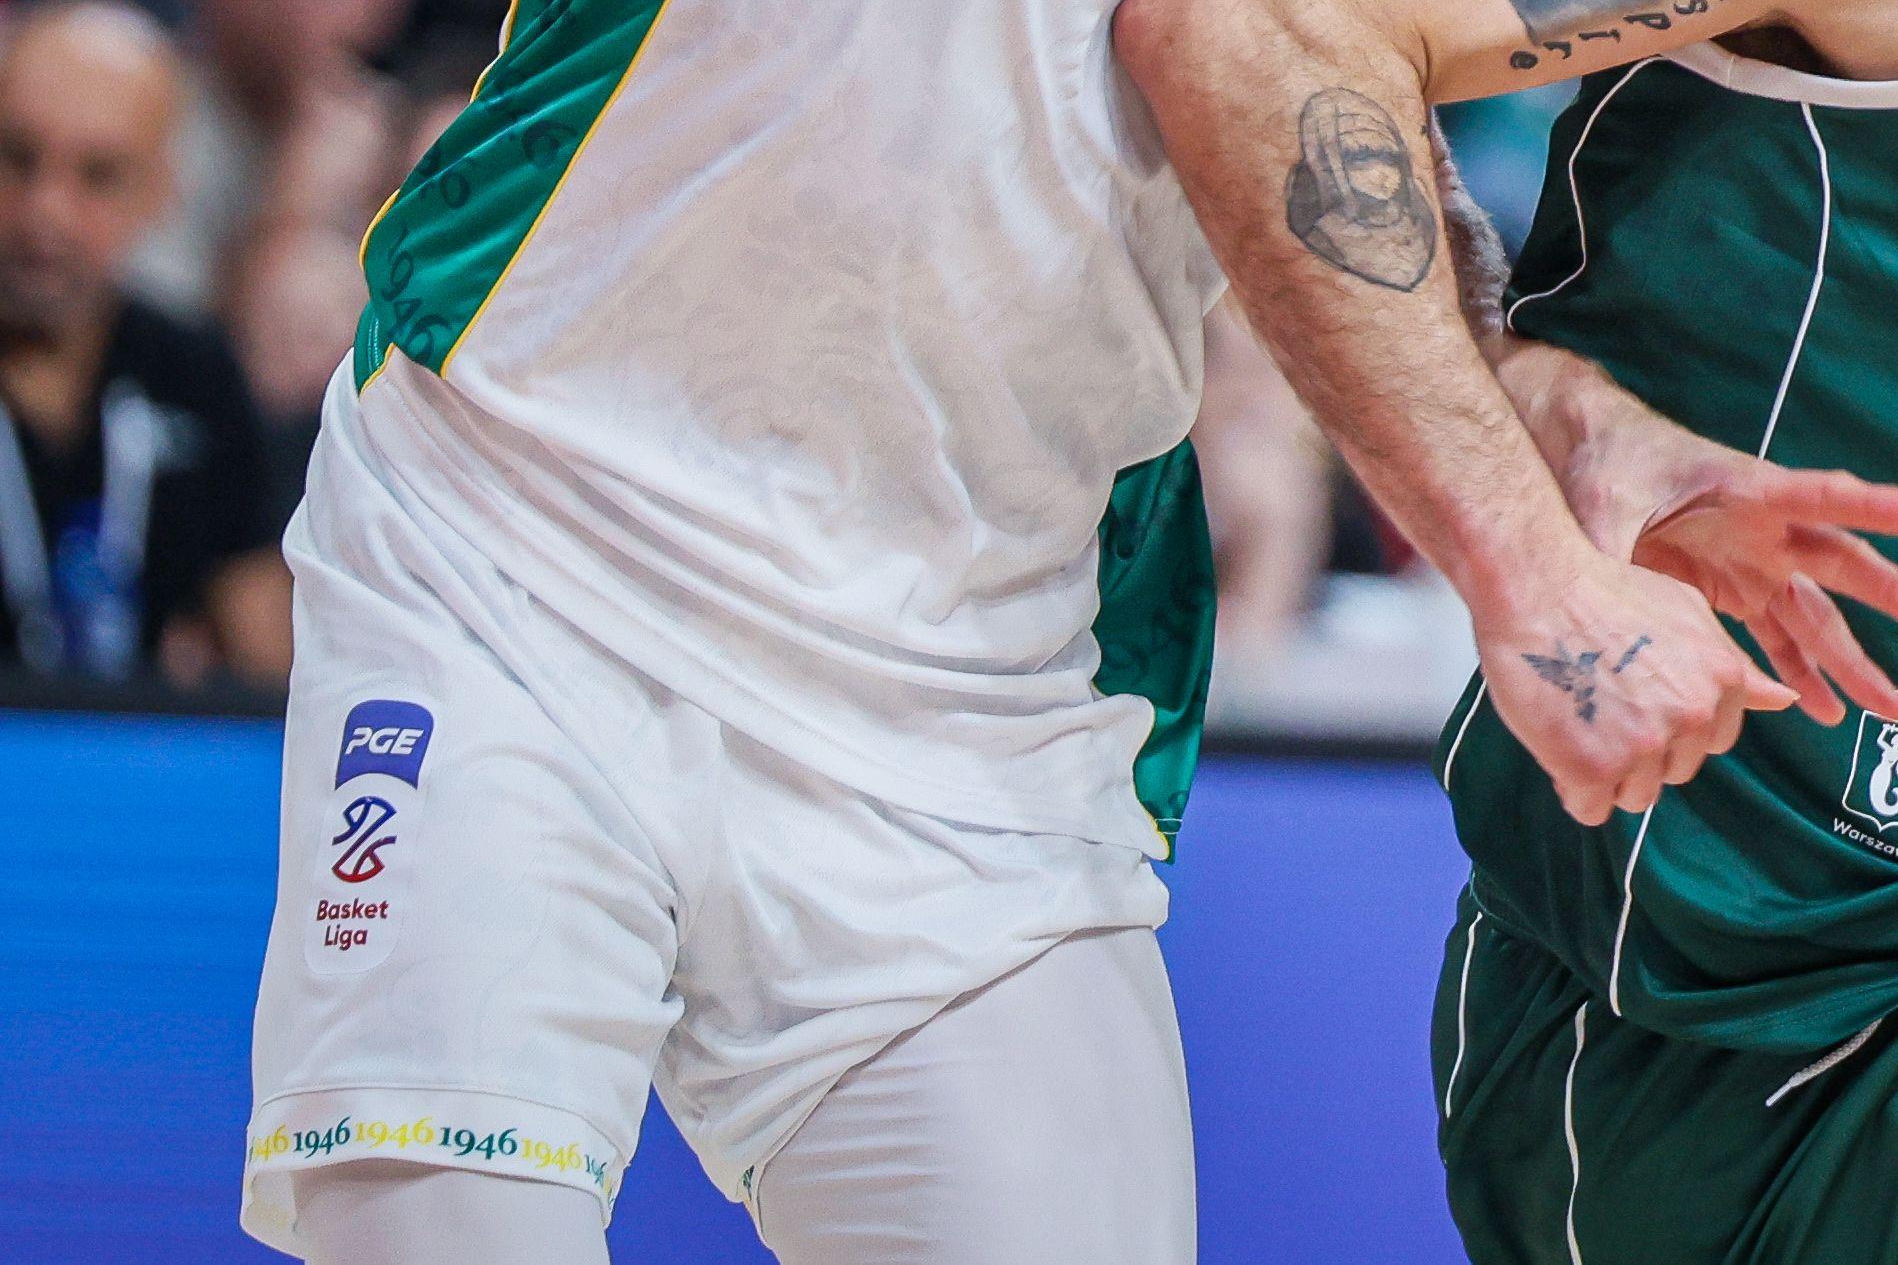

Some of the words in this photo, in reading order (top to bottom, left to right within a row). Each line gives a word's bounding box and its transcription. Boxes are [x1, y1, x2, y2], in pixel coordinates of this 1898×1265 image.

[345, 727, 424, 755] PGE
[316, 896, 389, 922] Basket
[324, 924, 368, 951] Liga
[293, 1116, 351, 1159] 1946
[355, 1117, 434, 1149] 1946
[440, 1126, 518, 1160] 1946
[520, 1137, 582, 1171] 1946
